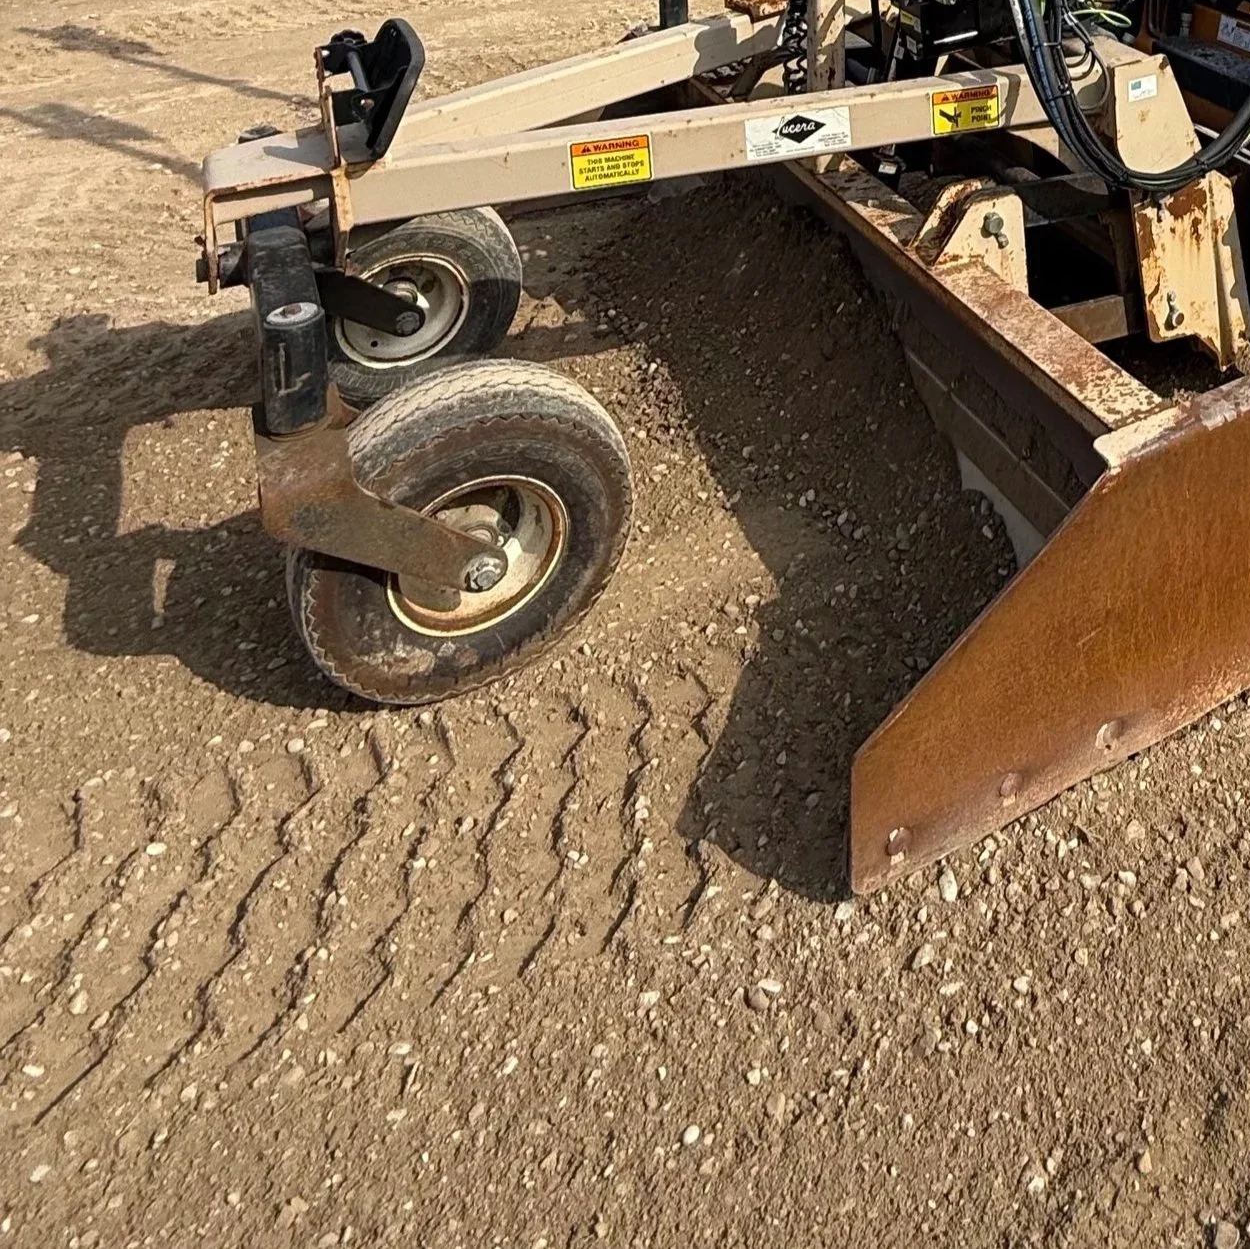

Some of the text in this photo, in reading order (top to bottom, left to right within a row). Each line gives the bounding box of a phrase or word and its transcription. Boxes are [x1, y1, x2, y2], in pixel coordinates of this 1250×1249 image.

[952, 88, 992, 100] WARNING
[970, 104, 992, 113] PINCH
[971, 113, 991, 123] POINT
[593, 139, 640, 151] WARNING
[604, 153, 635, 162] MACHINE
[579, 160, 644, 174] STARTS AND STOPS
[585, 168, 639, 181] AUTOMATICALLY
